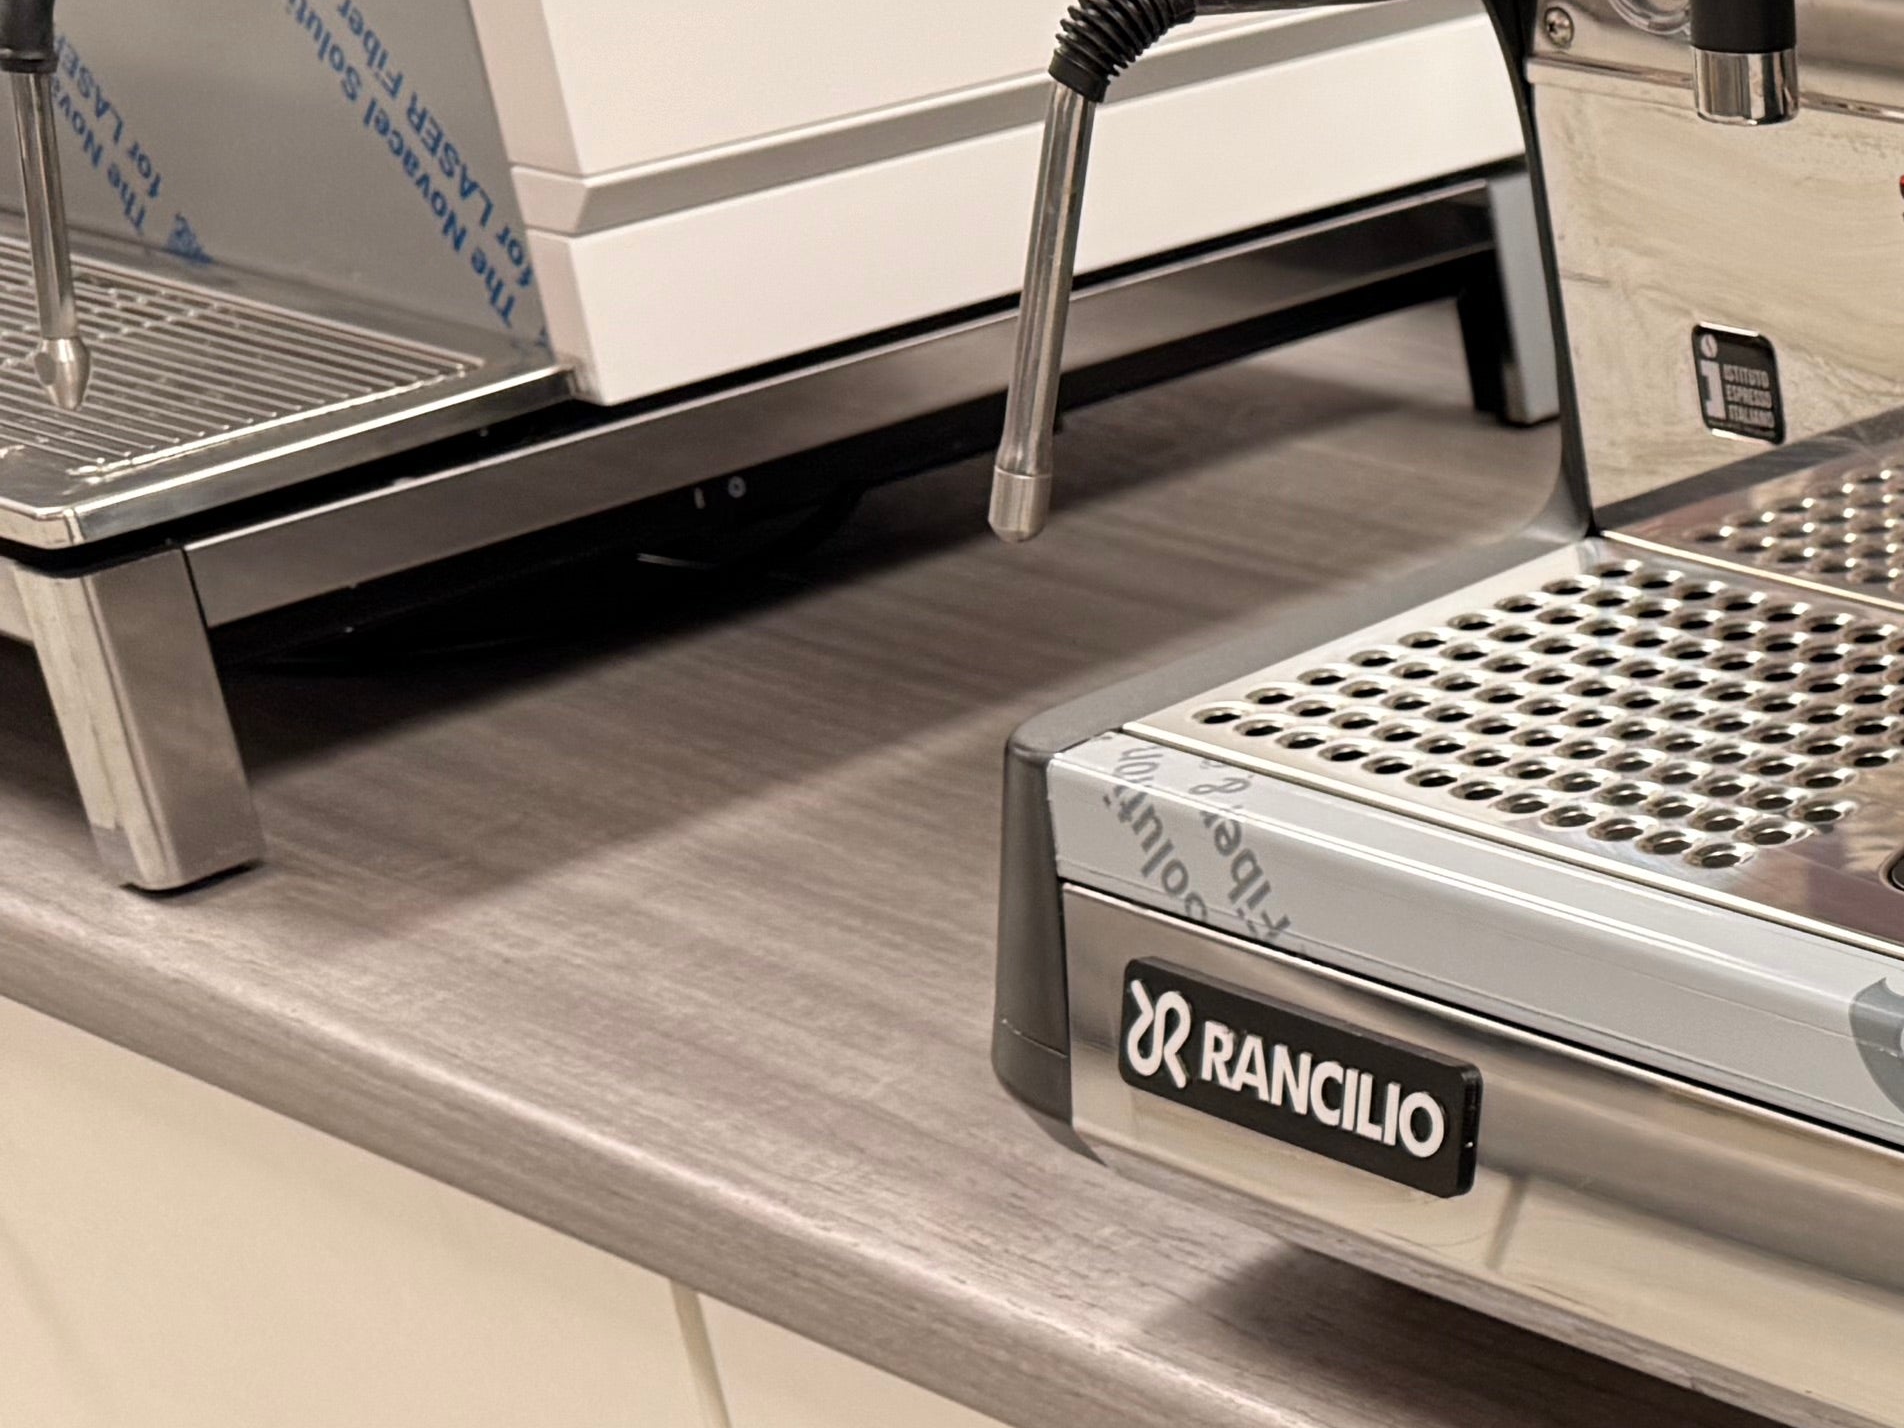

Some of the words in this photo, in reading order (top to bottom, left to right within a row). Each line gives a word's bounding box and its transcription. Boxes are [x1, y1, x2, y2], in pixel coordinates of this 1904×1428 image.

[126, 141, 163, 200] for
[362, 101, 467, 252] Novacel
[405, 92, 494, 229] LASER
[470, 248, 517, 328] The
[494, 224, 535, 289] for
[1200, 1019, 1446, 1158] RANCILIO
